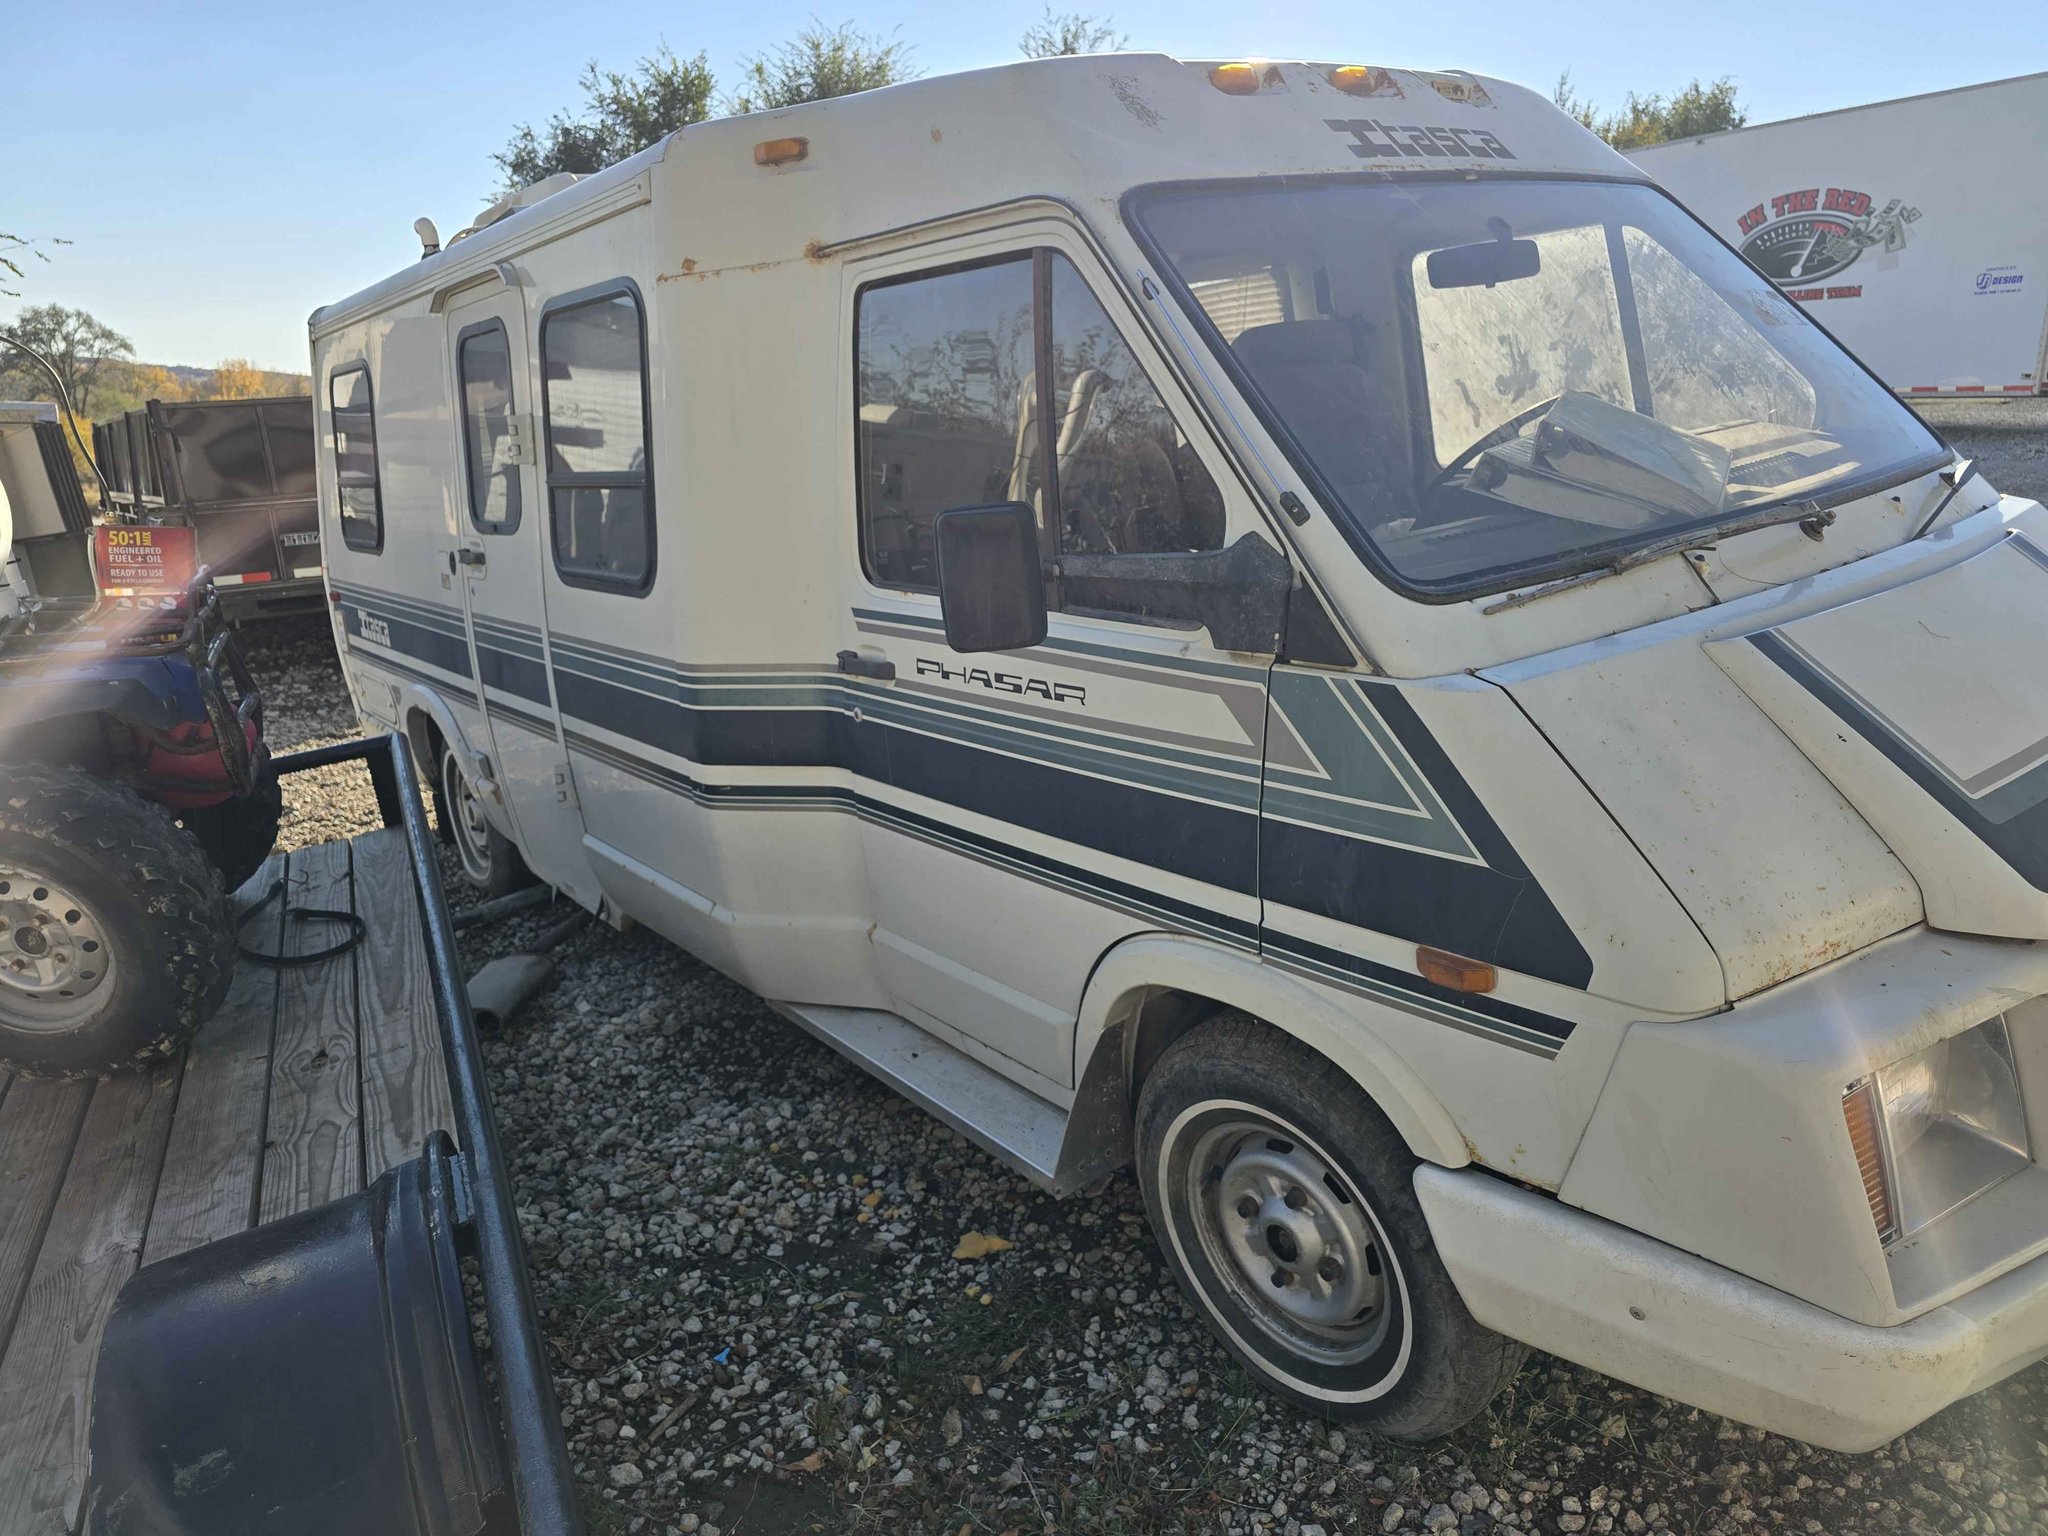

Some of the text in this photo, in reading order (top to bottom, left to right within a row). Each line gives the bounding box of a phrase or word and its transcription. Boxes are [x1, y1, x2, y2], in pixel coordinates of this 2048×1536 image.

[1322, 119, 1517, 159] Itasca
[1737, 188, 1872, 236] IN THE RED
[1992, 275, 2023, 285] DESIGN
[1827, 285, 1863, 299] TEAM
[108, 531, 152, 546] 50:1 MIX
[108, 547, 162, 555] ENGINEERED
[109, 555, 134, 563] FUEL
[146, 555, 163, 563] OIL
[110, 569, 164, 577] READY TO USE
[358, 608, 391, 647] Itasca
[916, 658, 1086, 706] PHASAR
